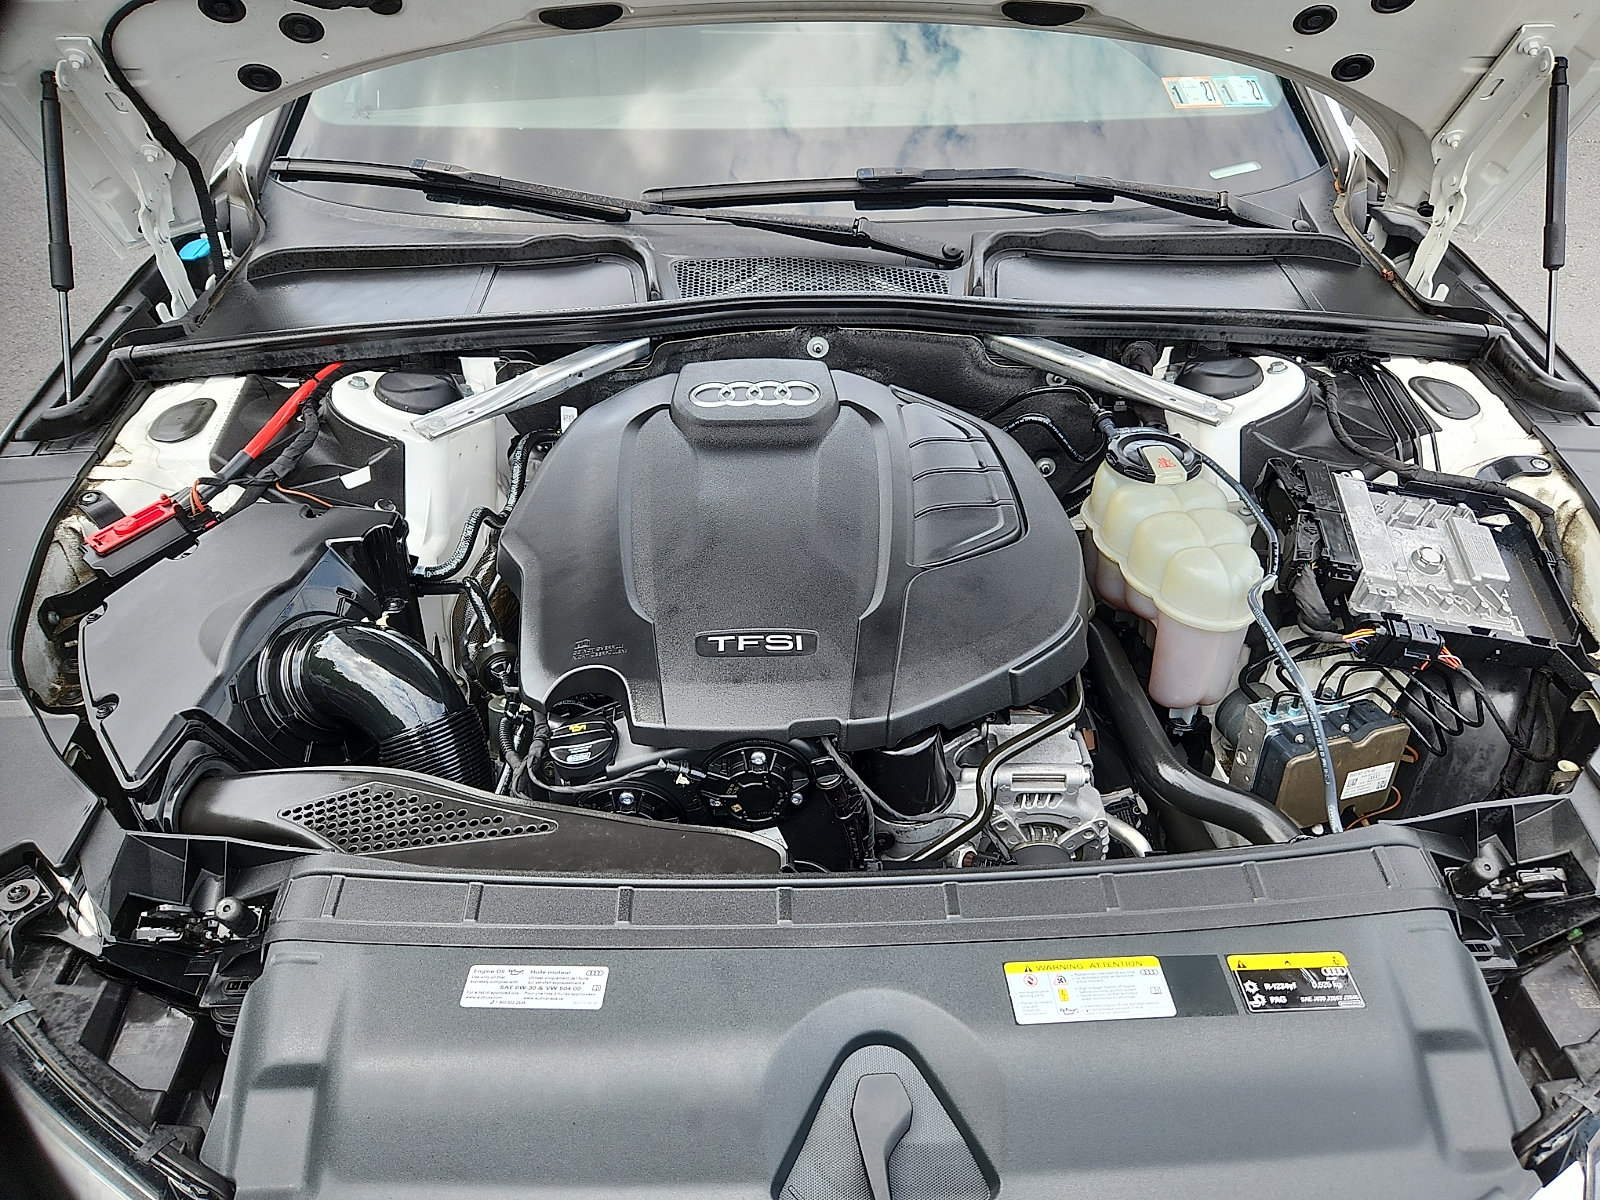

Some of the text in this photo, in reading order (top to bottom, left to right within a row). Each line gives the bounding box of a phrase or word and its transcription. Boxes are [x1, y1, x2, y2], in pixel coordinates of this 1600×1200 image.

[707, 634, 803, 652] TFSI
[1035, 960, 1143, 971] WARNING ATTENTION
[1269, 995, 1288, 1004] PAG
